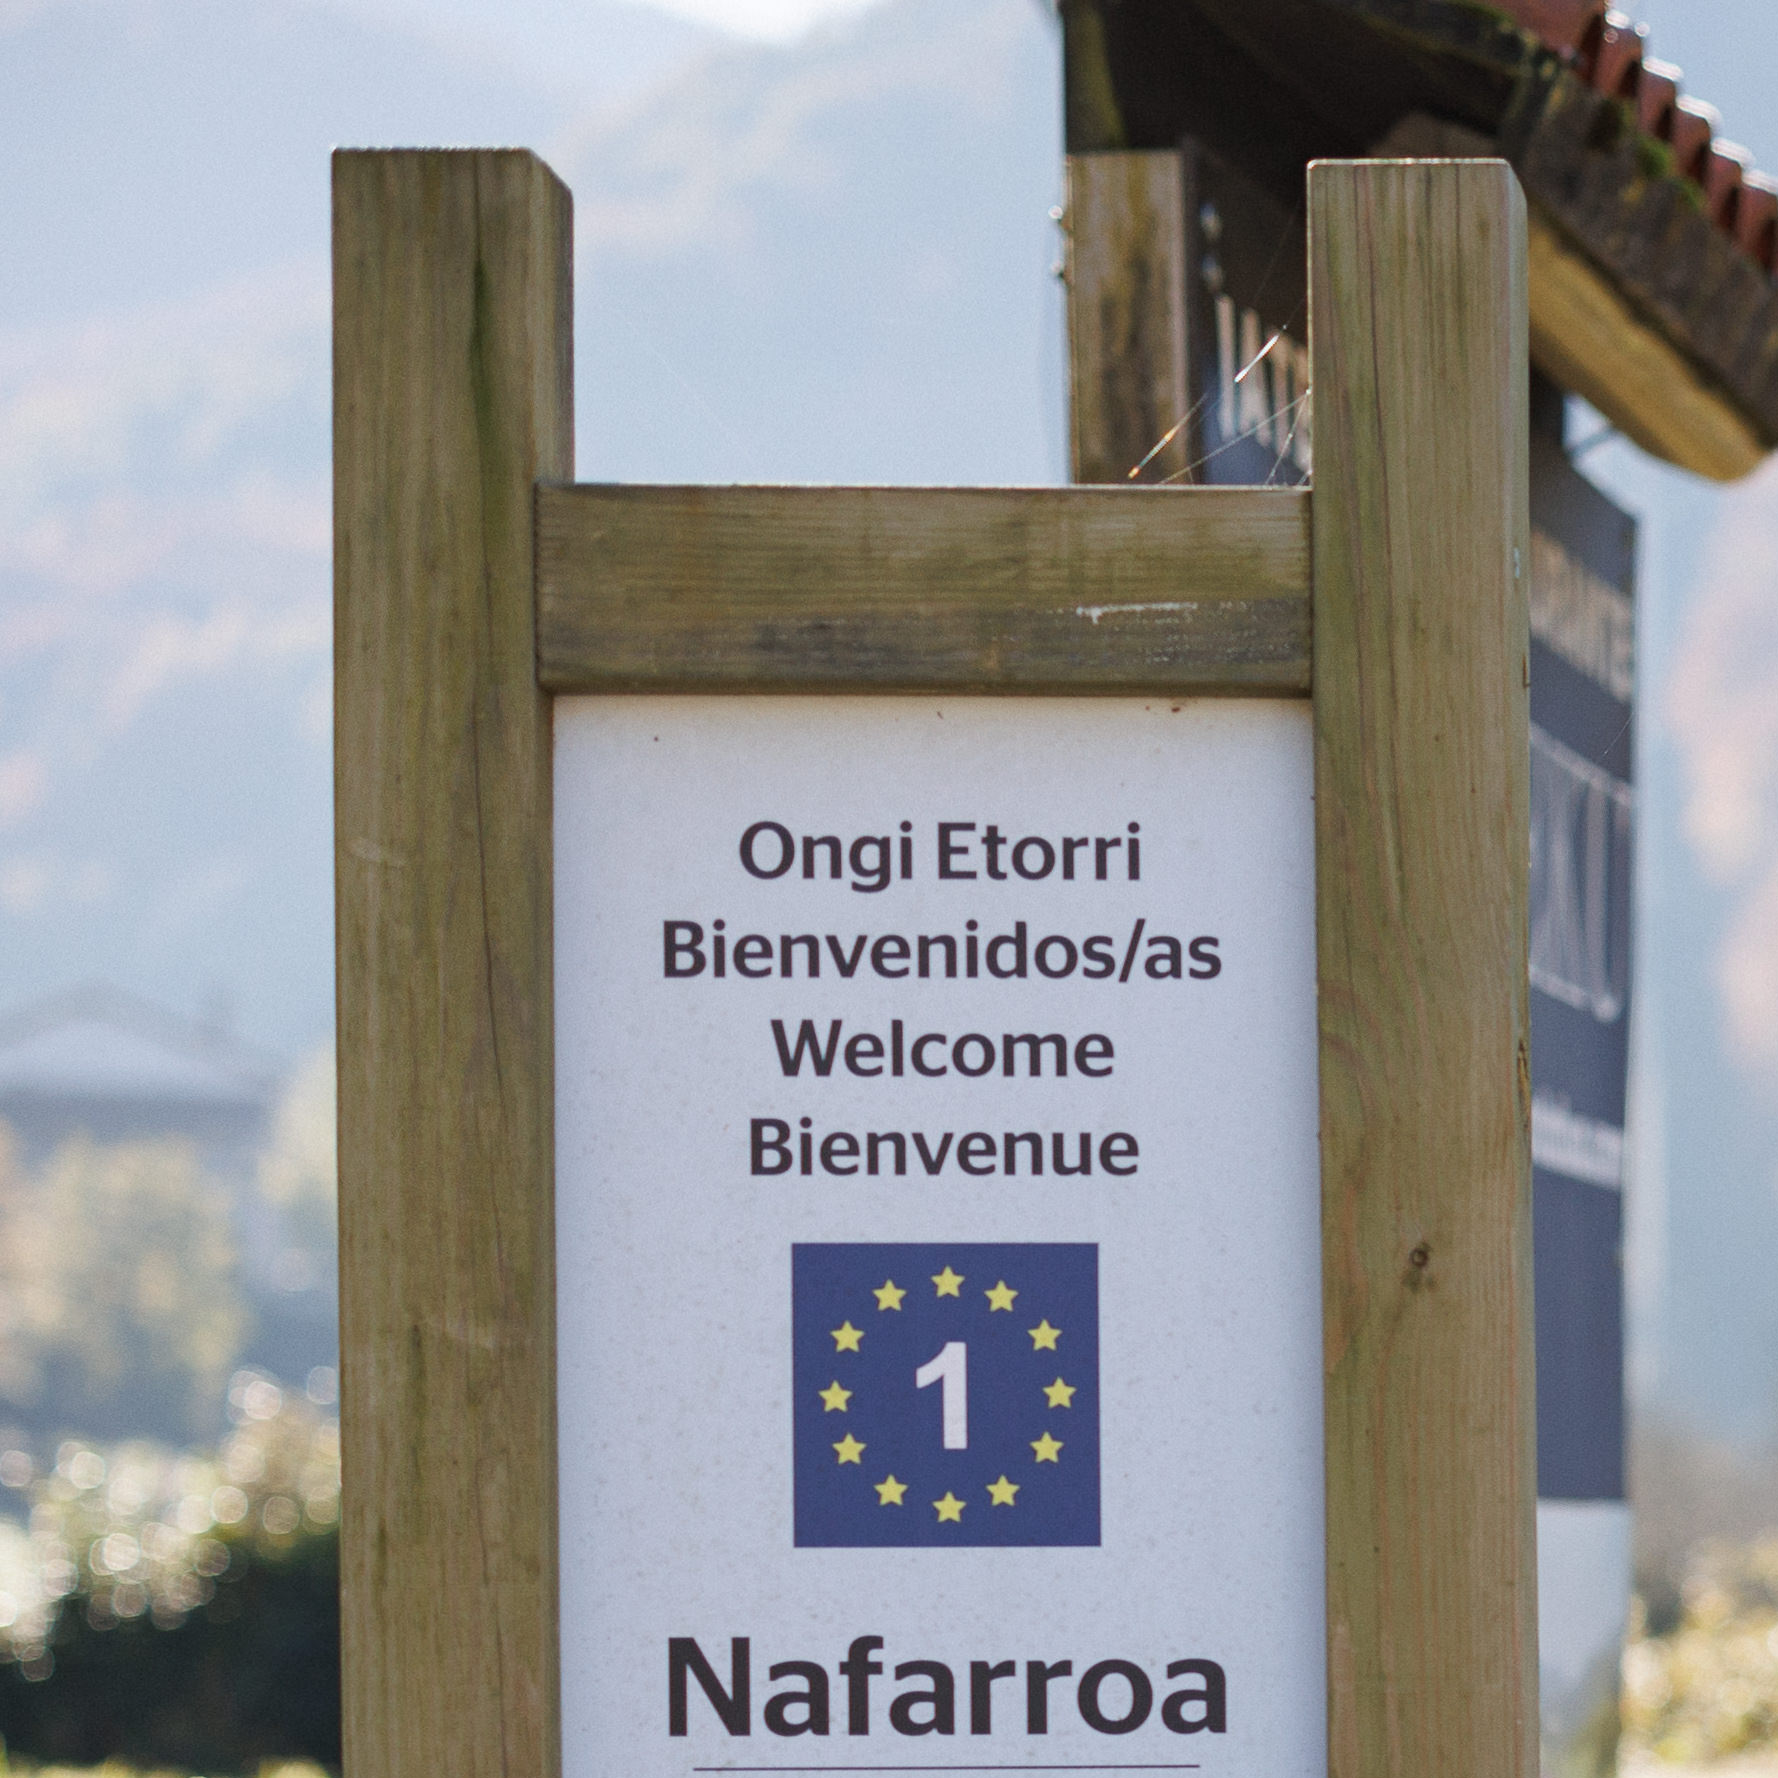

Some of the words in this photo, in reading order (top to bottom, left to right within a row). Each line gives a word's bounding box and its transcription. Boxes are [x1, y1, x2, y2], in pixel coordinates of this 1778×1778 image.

[740, 821, 912, 893] Ongi
[938, 822, 1140, 881] Etorri
[663, 918, 1222, 983] Bienvenidos/as
[770, 1019, 1115, 1078] Welcome
[750, 1117, 1139, 1177] Bienvenue
[915, 1341, 968, 1450] 1
[668, 1636, 1227, 1737] Nafarroa
